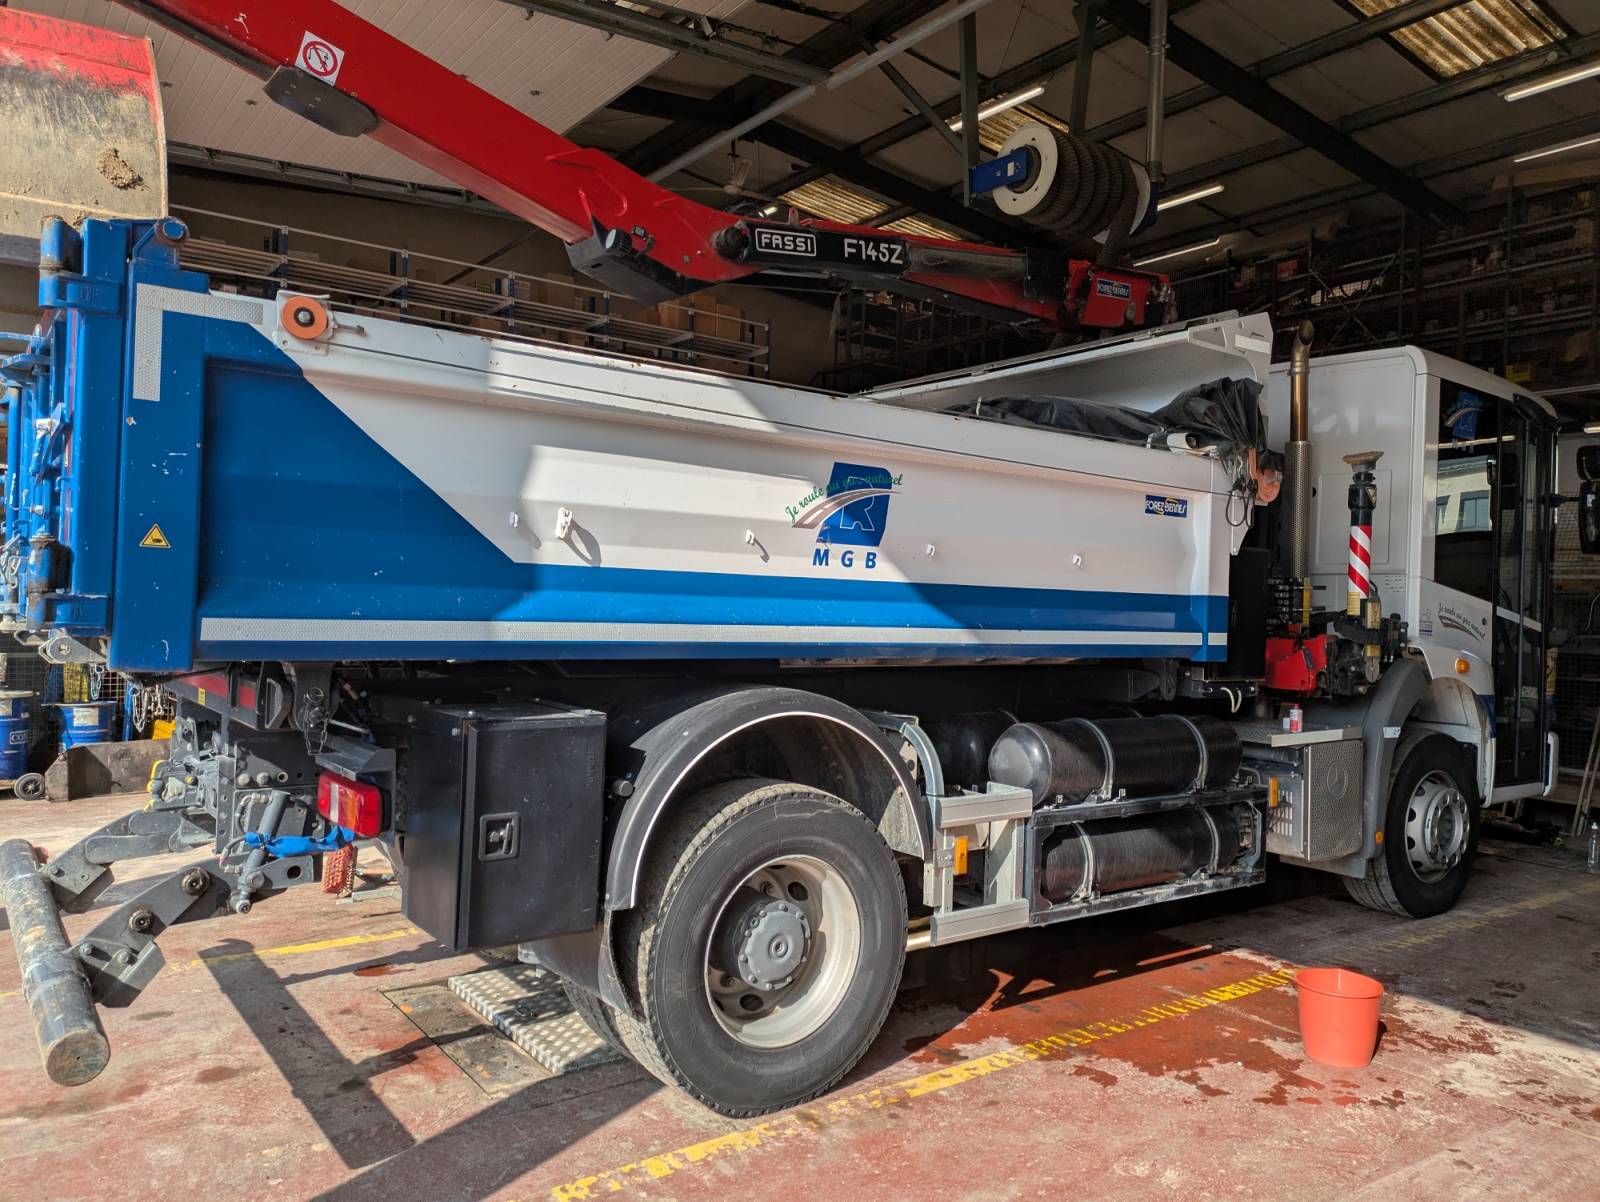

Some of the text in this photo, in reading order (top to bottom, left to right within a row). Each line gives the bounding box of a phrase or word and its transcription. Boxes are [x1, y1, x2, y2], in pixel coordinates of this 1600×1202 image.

[761, 234, 904, 265] FASSI F145Z
[785, 504, 799, 524] Je
[798, 486, 825, 509] roule
